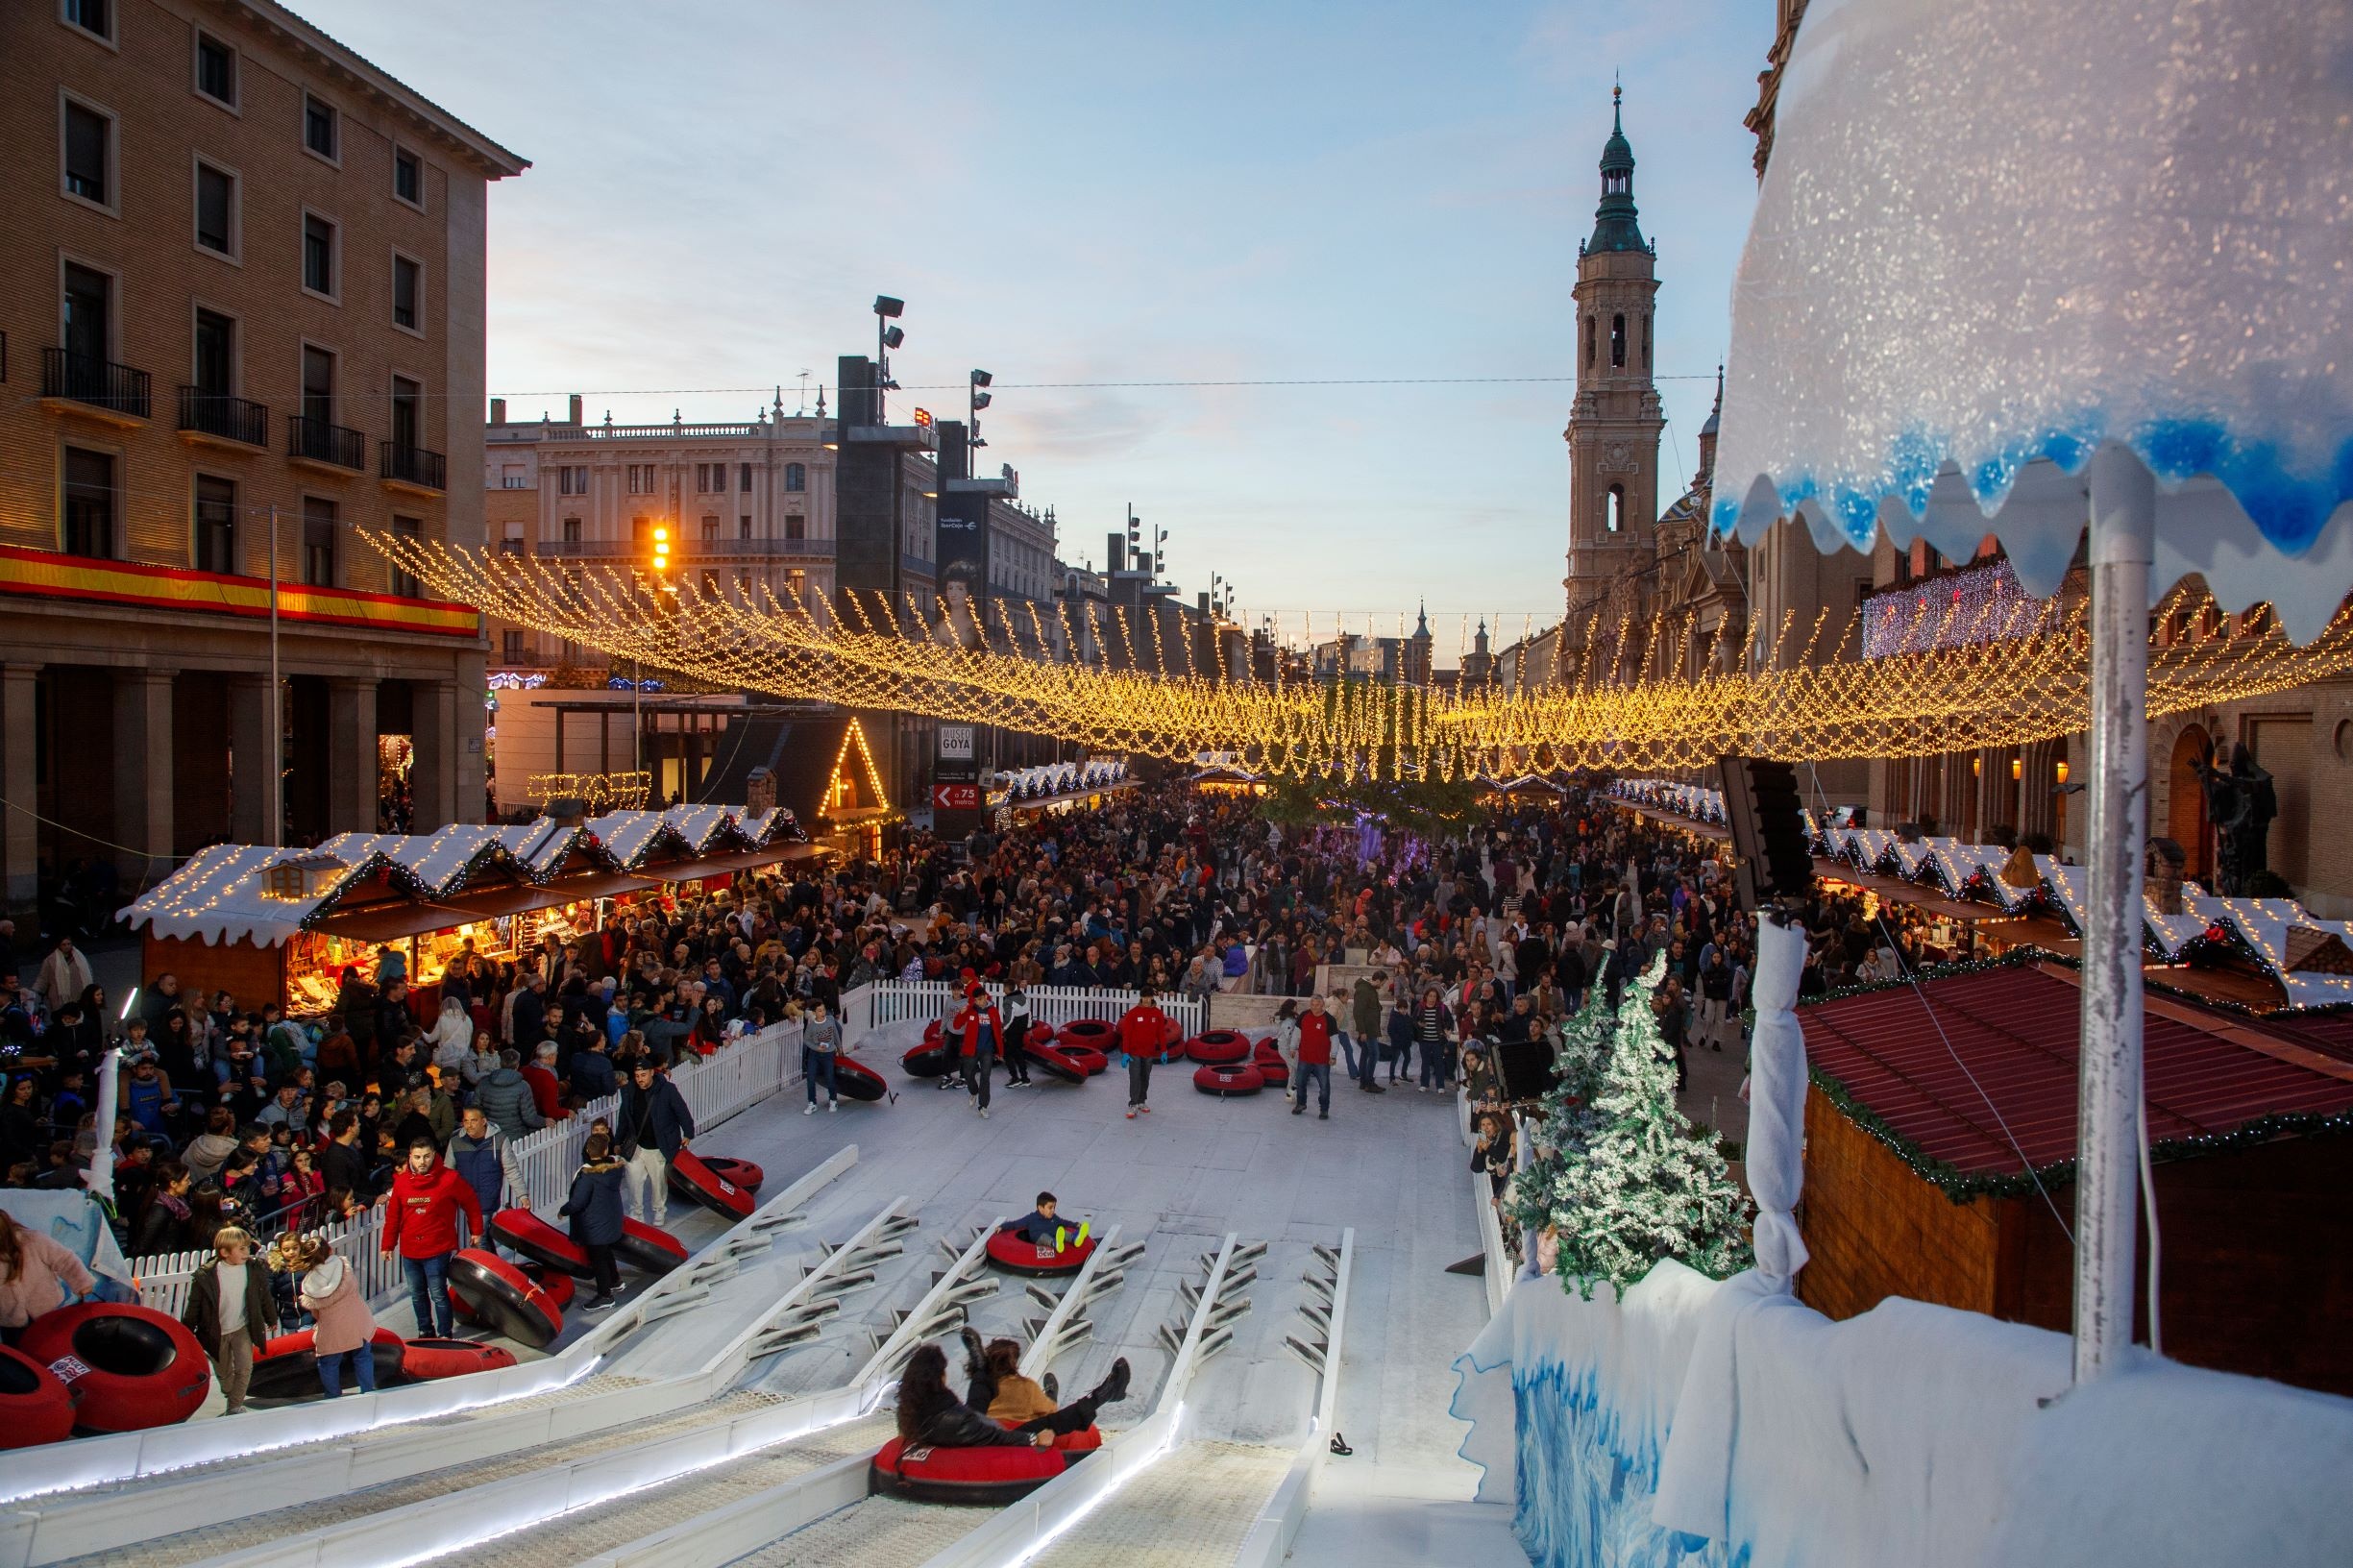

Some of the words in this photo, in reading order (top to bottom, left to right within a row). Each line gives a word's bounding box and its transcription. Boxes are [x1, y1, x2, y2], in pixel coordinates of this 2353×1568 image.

[943, 728, 970, 739] MUSEO
[943, 739, 970, 749] GOYA
[961, 789, 975, 798] 75
[63, 1357, 86, 1373] MULTI
